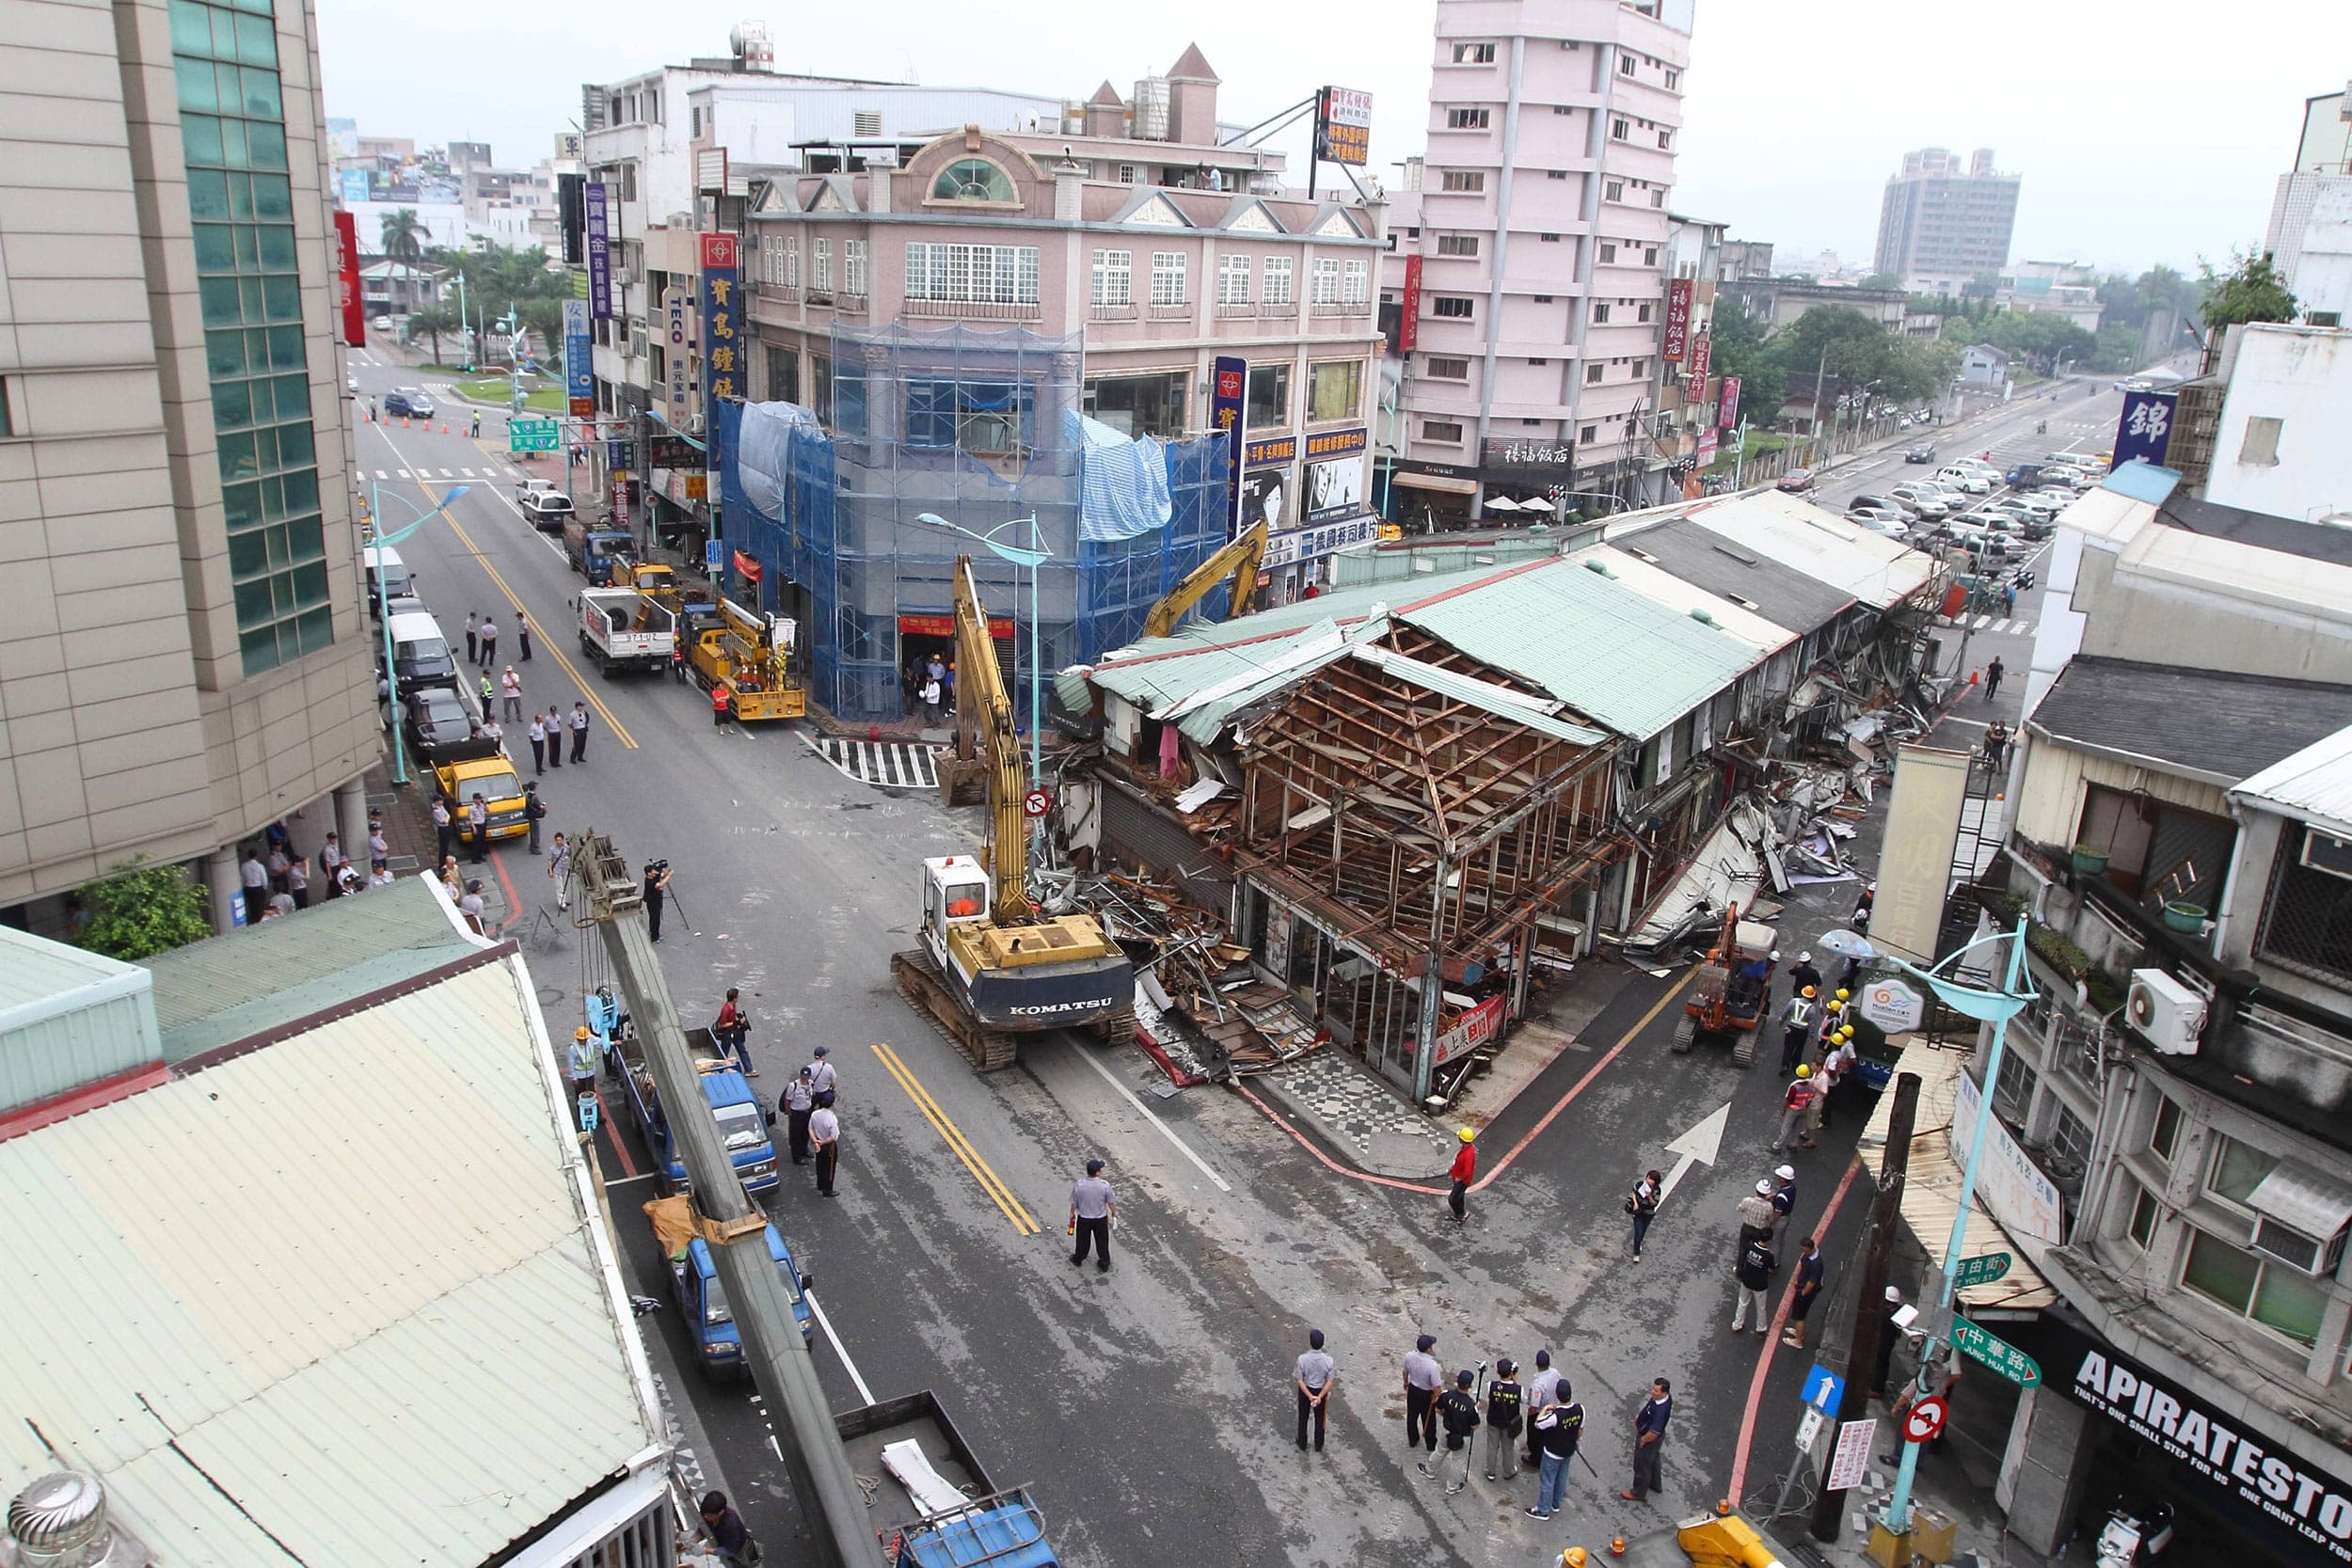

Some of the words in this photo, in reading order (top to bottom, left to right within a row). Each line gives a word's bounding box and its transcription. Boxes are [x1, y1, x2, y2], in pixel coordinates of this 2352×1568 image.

[671, 296, 683, 344] TECO
[2127, 401, 2169, 464] 錦
[1009, 997, 1113, 1015] KOMATSU
[1964, 1345, 1986, 1362] JUNG
[1988, 1358, 2005, 1375] HUA
[2009, 1370, 2021, 1383] RD
[1968, 1329, 2026, 1371] 中華路
[2074, 1385, 2107, 1411] THAT'S
[2107, 1405, 2127, 1424] ONE
[2128, 1418, 2161, 1446] SMALL
[2163, 1443, 2189, 1460] STEP
[2191, 1456, 2211, 1477] FOR
[2214, 1470, 2230, 1486] US
[2239, 1486, 2261, 1506] ONE
[2263, 1500, 2296, 1527] GIANT
[2297, 1522, 2328, 1544] LEAP
